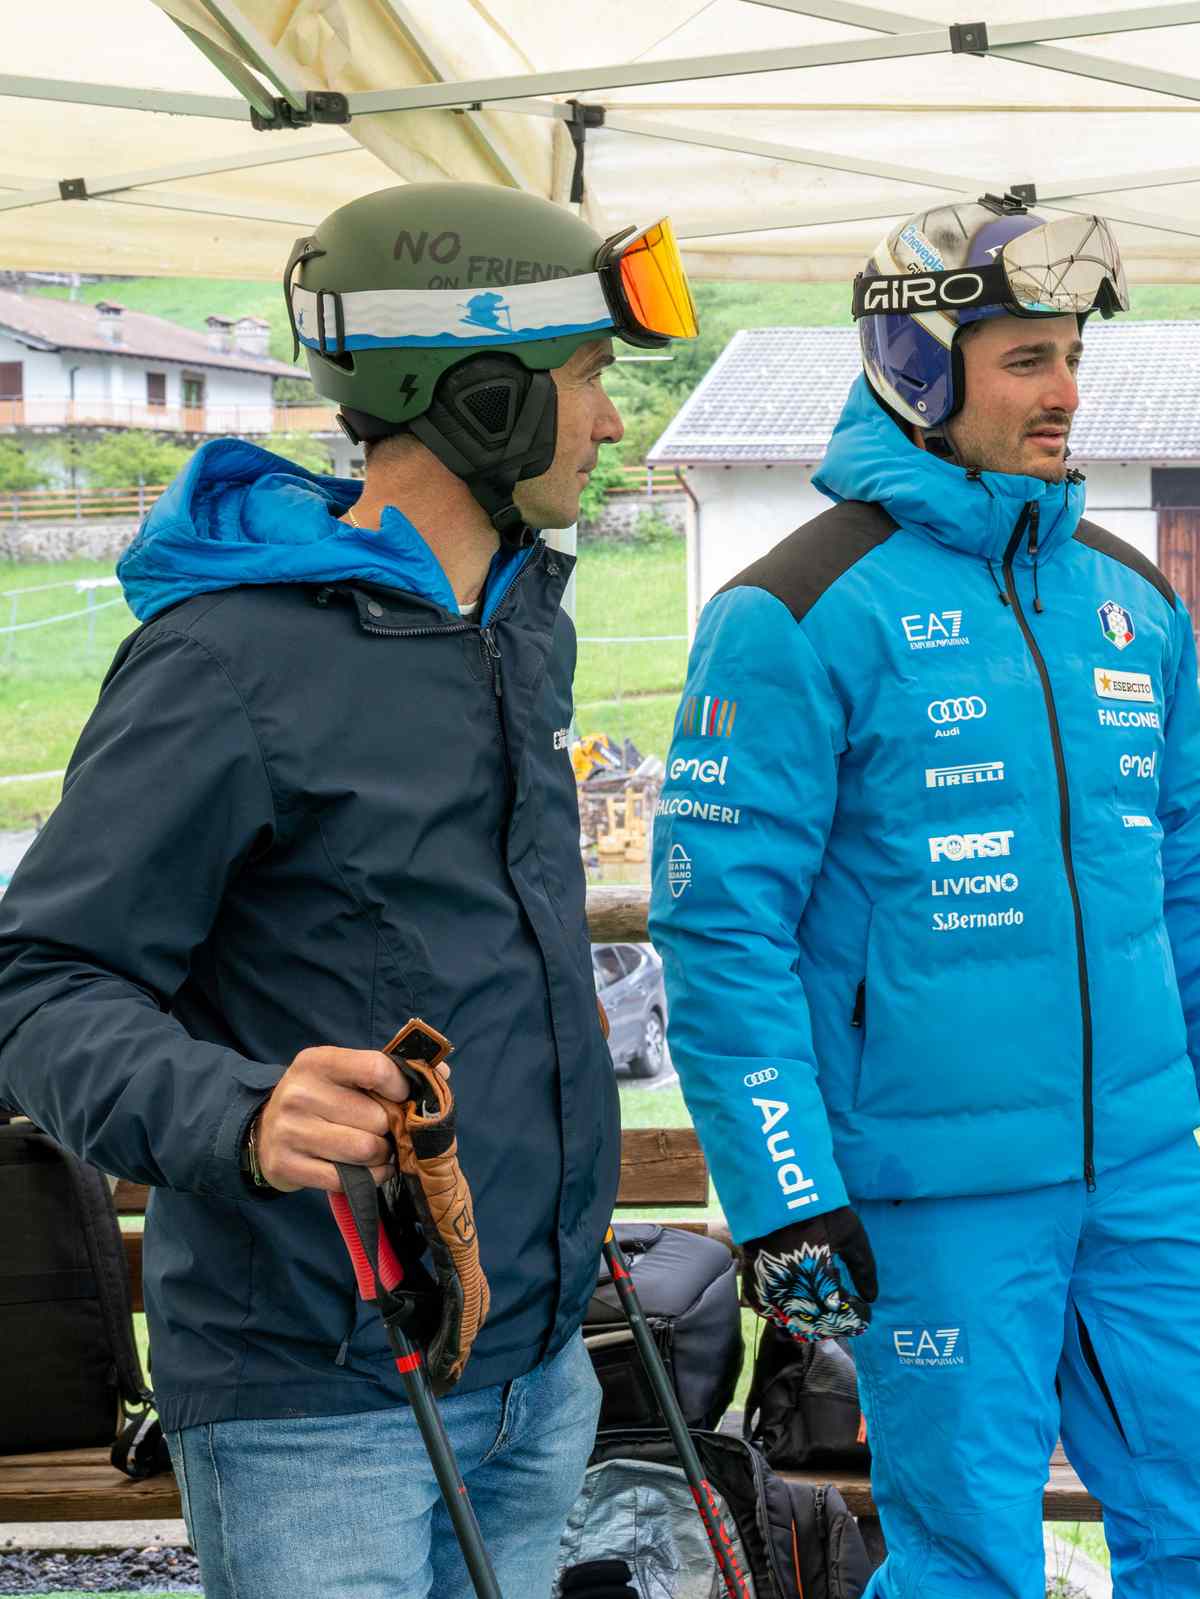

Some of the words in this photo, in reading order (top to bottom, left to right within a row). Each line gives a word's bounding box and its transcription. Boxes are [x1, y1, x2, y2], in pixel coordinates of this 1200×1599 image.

[393, 230, 461, 265] NO
[467, 256, 584, 284] FRIEND
[864, 273, 983, 310] GIRO
[901, 610, 962, 641] EA7
[1113, 681, 1151, 694] ESERCITO
[934, 727, 960, 738] Audi
[670, 756, 728, 785] enel
[925, 761, 1004, 788] PIRELLI
[1120, 752, 1156, 778] enel
[928, 830, 1014, 863] FORST
[931, 873, 1018, 896] LIVIGNO
[932, 907, 1024, 931] S.Bernardo
[752, 1097, 819, 1209] Audi
[894, 1328, 960, 1357] EA7
